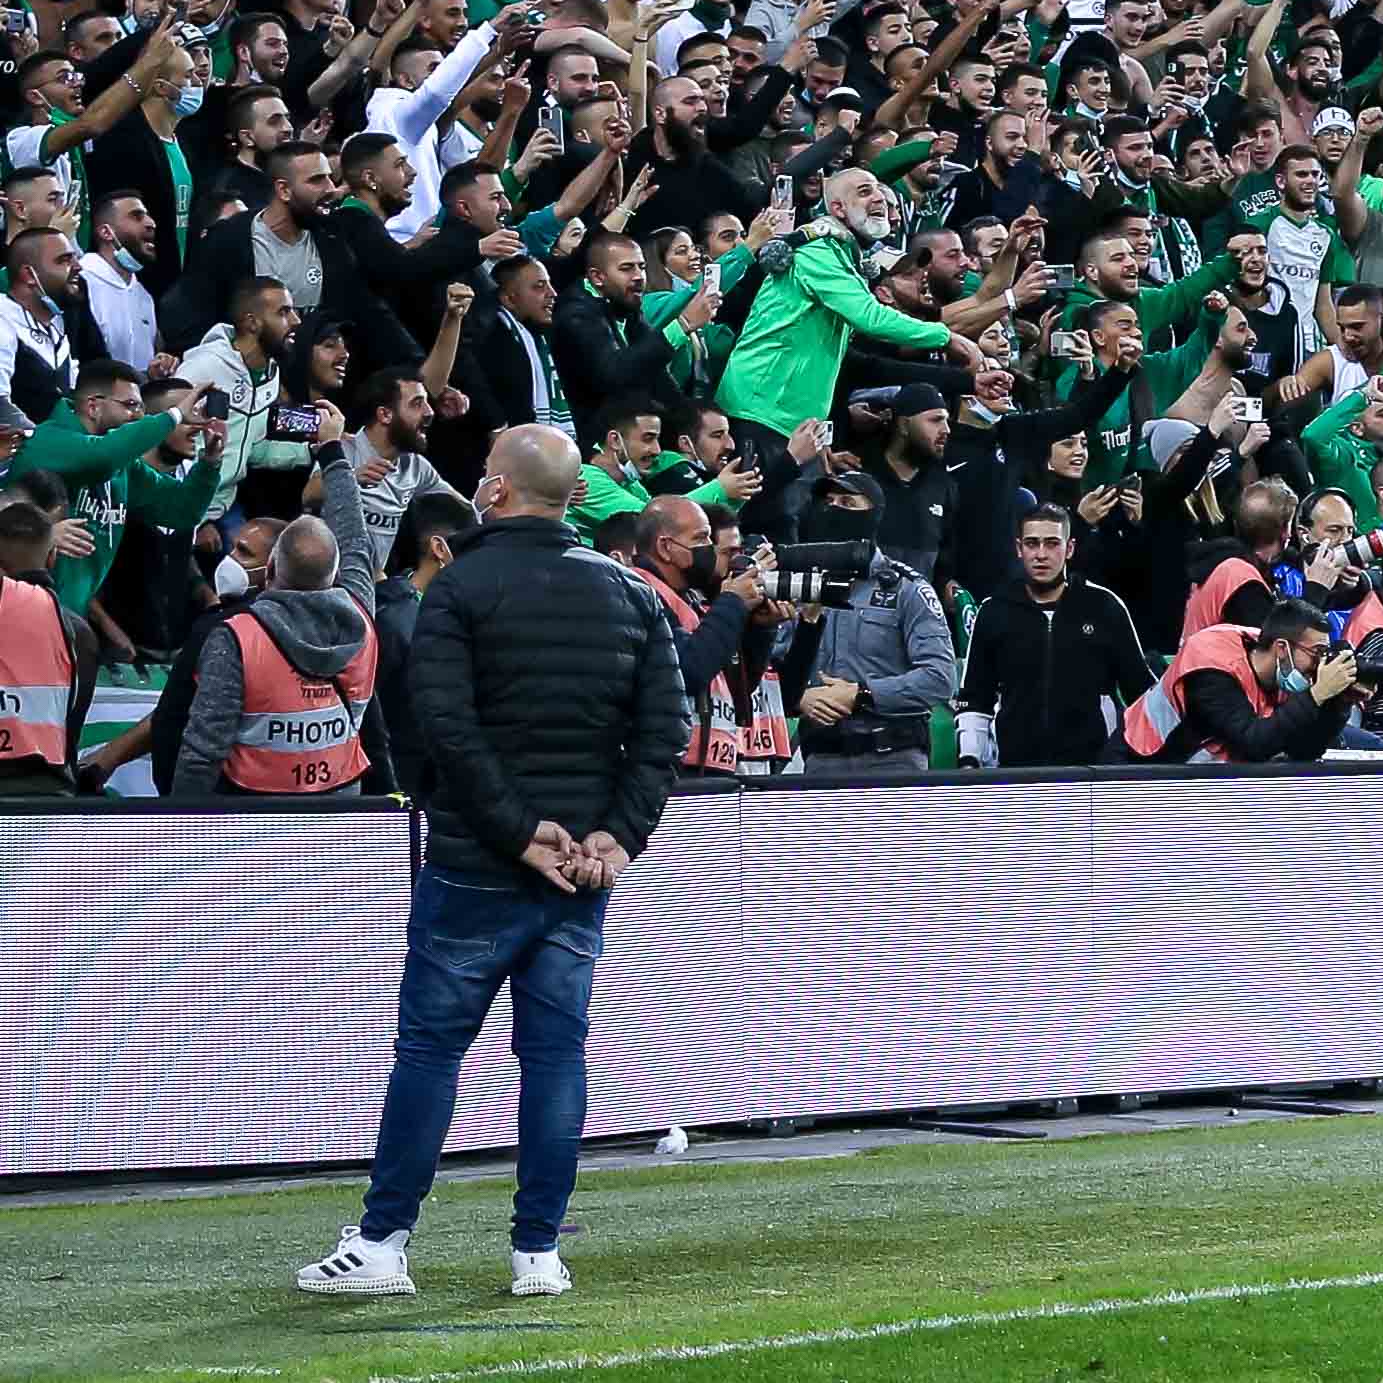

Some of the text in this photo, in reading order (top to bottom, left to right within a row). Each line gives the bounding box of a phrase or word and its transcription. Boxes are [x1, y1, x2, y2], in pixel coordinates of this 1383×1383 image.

[267, 719, 346, 745] PHOTO
[743, 729, 772, 752] 146
[710, 741, 736, 765] 129
[290, 761, 331, 787] 183
